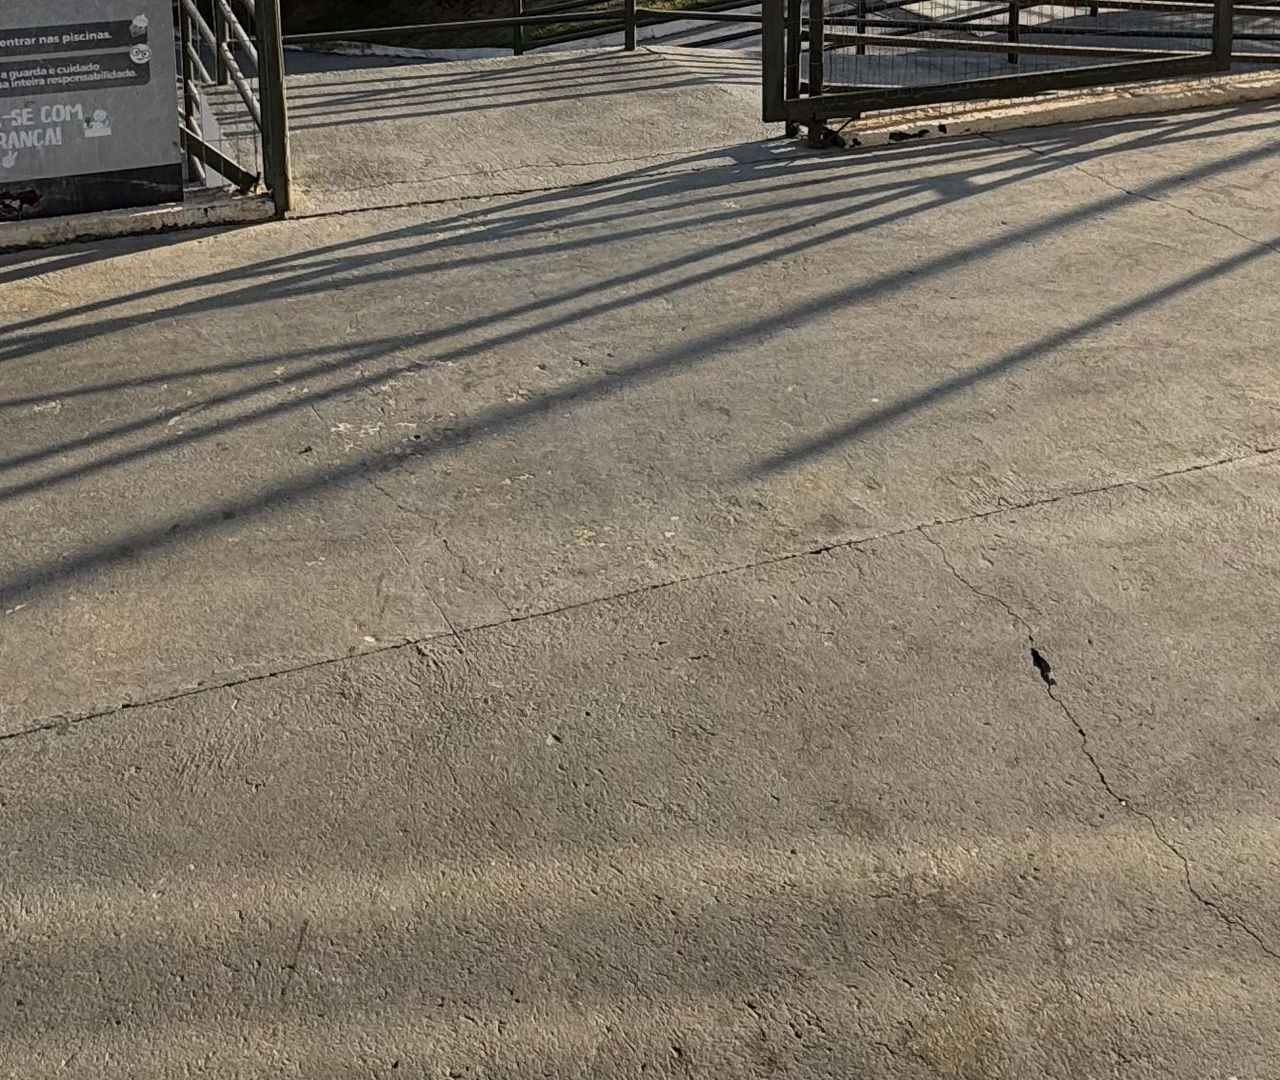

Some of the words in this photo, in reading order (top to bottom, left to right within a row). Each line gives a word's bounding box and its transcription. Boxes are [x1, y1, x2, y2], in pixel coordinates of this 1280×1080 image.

[39, 35, 59, 44] nas
[62, 30, 112, 44] piscinas.
[0, 71, 7, 79] a
[8, 66, 47, 80] guarda
[57, 62, 100, 75] cuidado
[11, 75, 45, 87] inteira
[47, 68, 137, 86] responsabilidade.
[40, 103, 83, 123] COM
